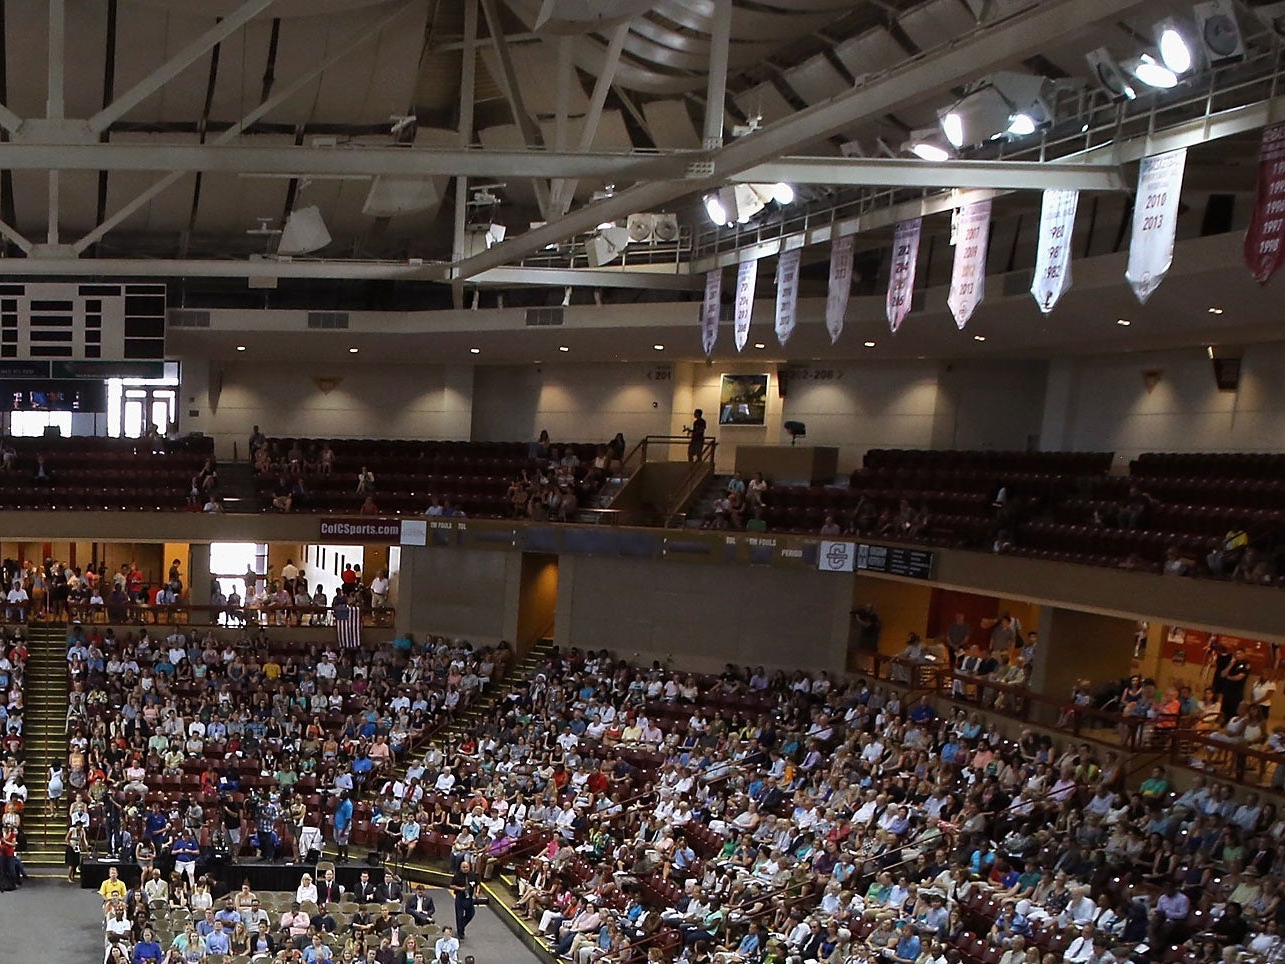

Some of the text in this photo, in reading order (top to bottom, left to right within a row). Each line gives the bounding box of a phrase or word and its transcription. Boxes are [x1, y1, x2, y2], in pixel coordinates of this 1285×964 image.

[1146, 192, 1167, 209] 2010
[1142, 215, 1164, 231] 2013
[321, 522, 399, 535] CofCSports.com
[781, 549, 803, 558] PERIOD
